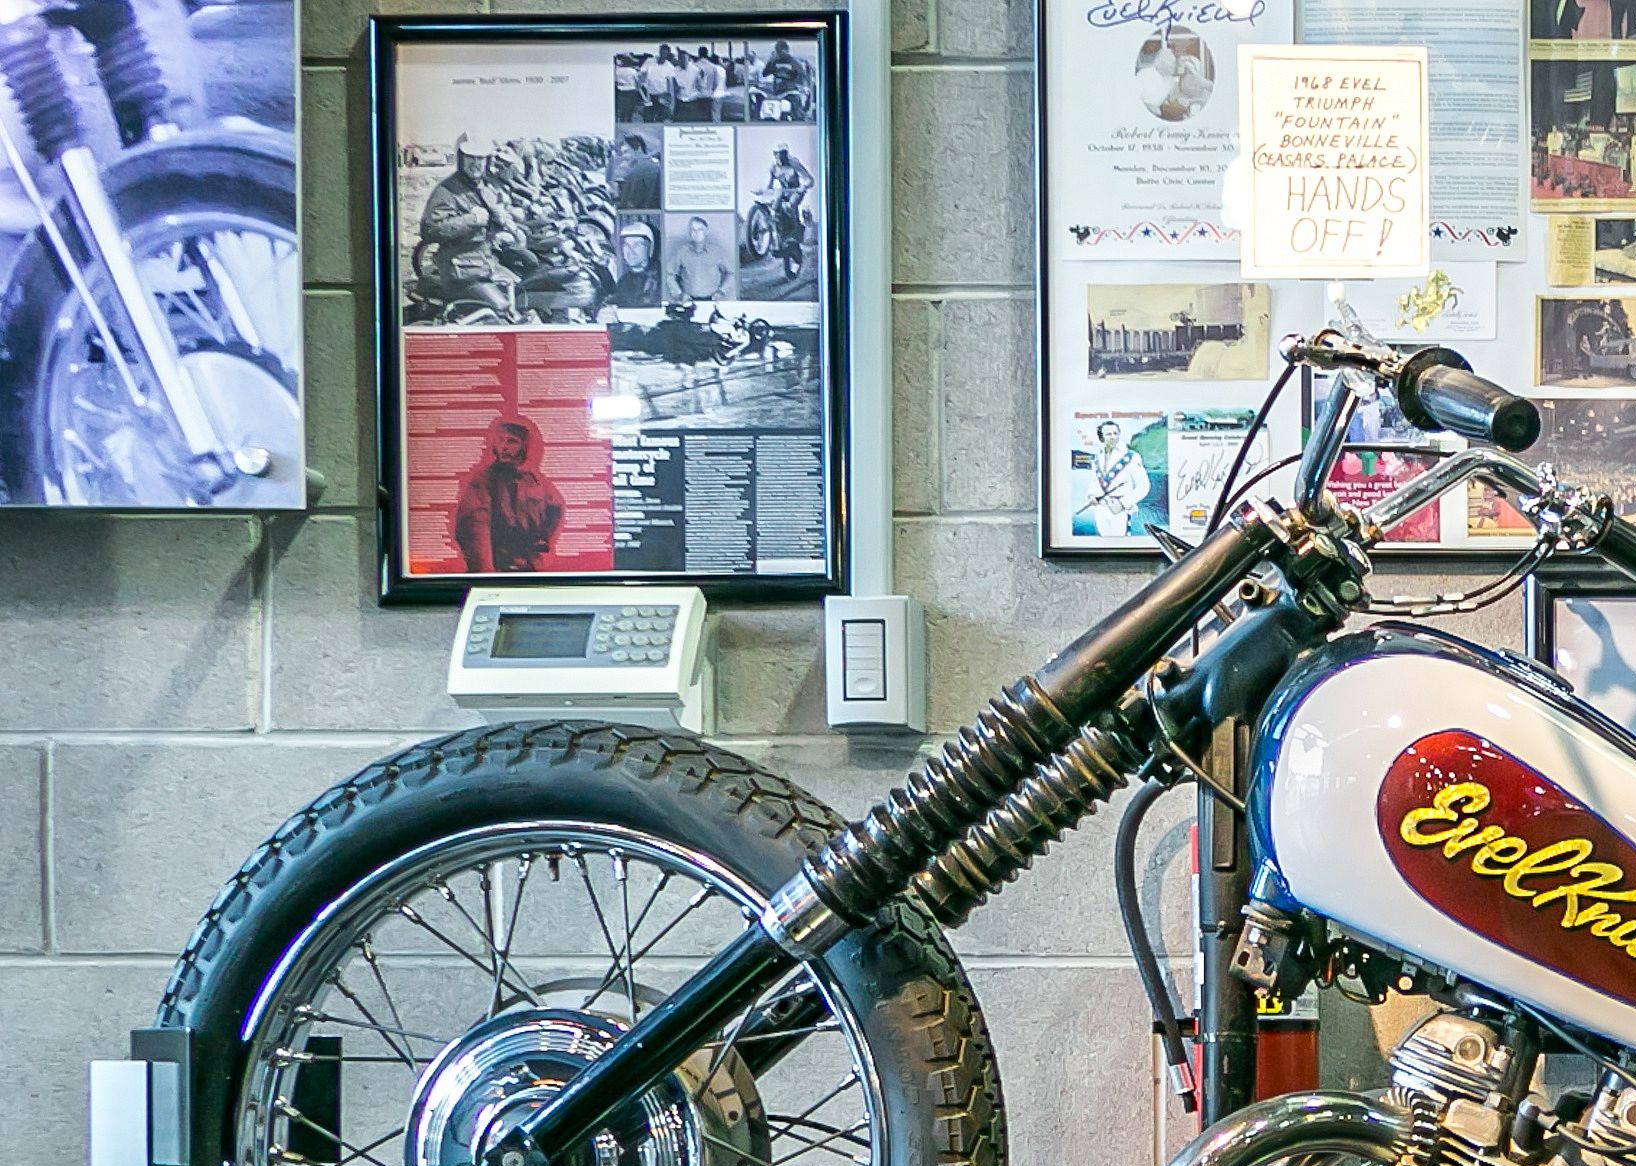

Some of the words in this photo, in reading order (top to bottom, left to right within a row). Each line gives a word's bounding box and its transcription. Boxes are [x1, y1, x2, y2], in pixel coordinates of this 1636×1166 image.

[1294, 76, 1333, 91] 1968
[1340, 76, 1386, 91] EVEL
[1293, 96, 1376, 111] TRIUMPH
[1280, 134, 1399, 148] BONNEVILLE
[1287, 175, 1407, 213] HANDS
